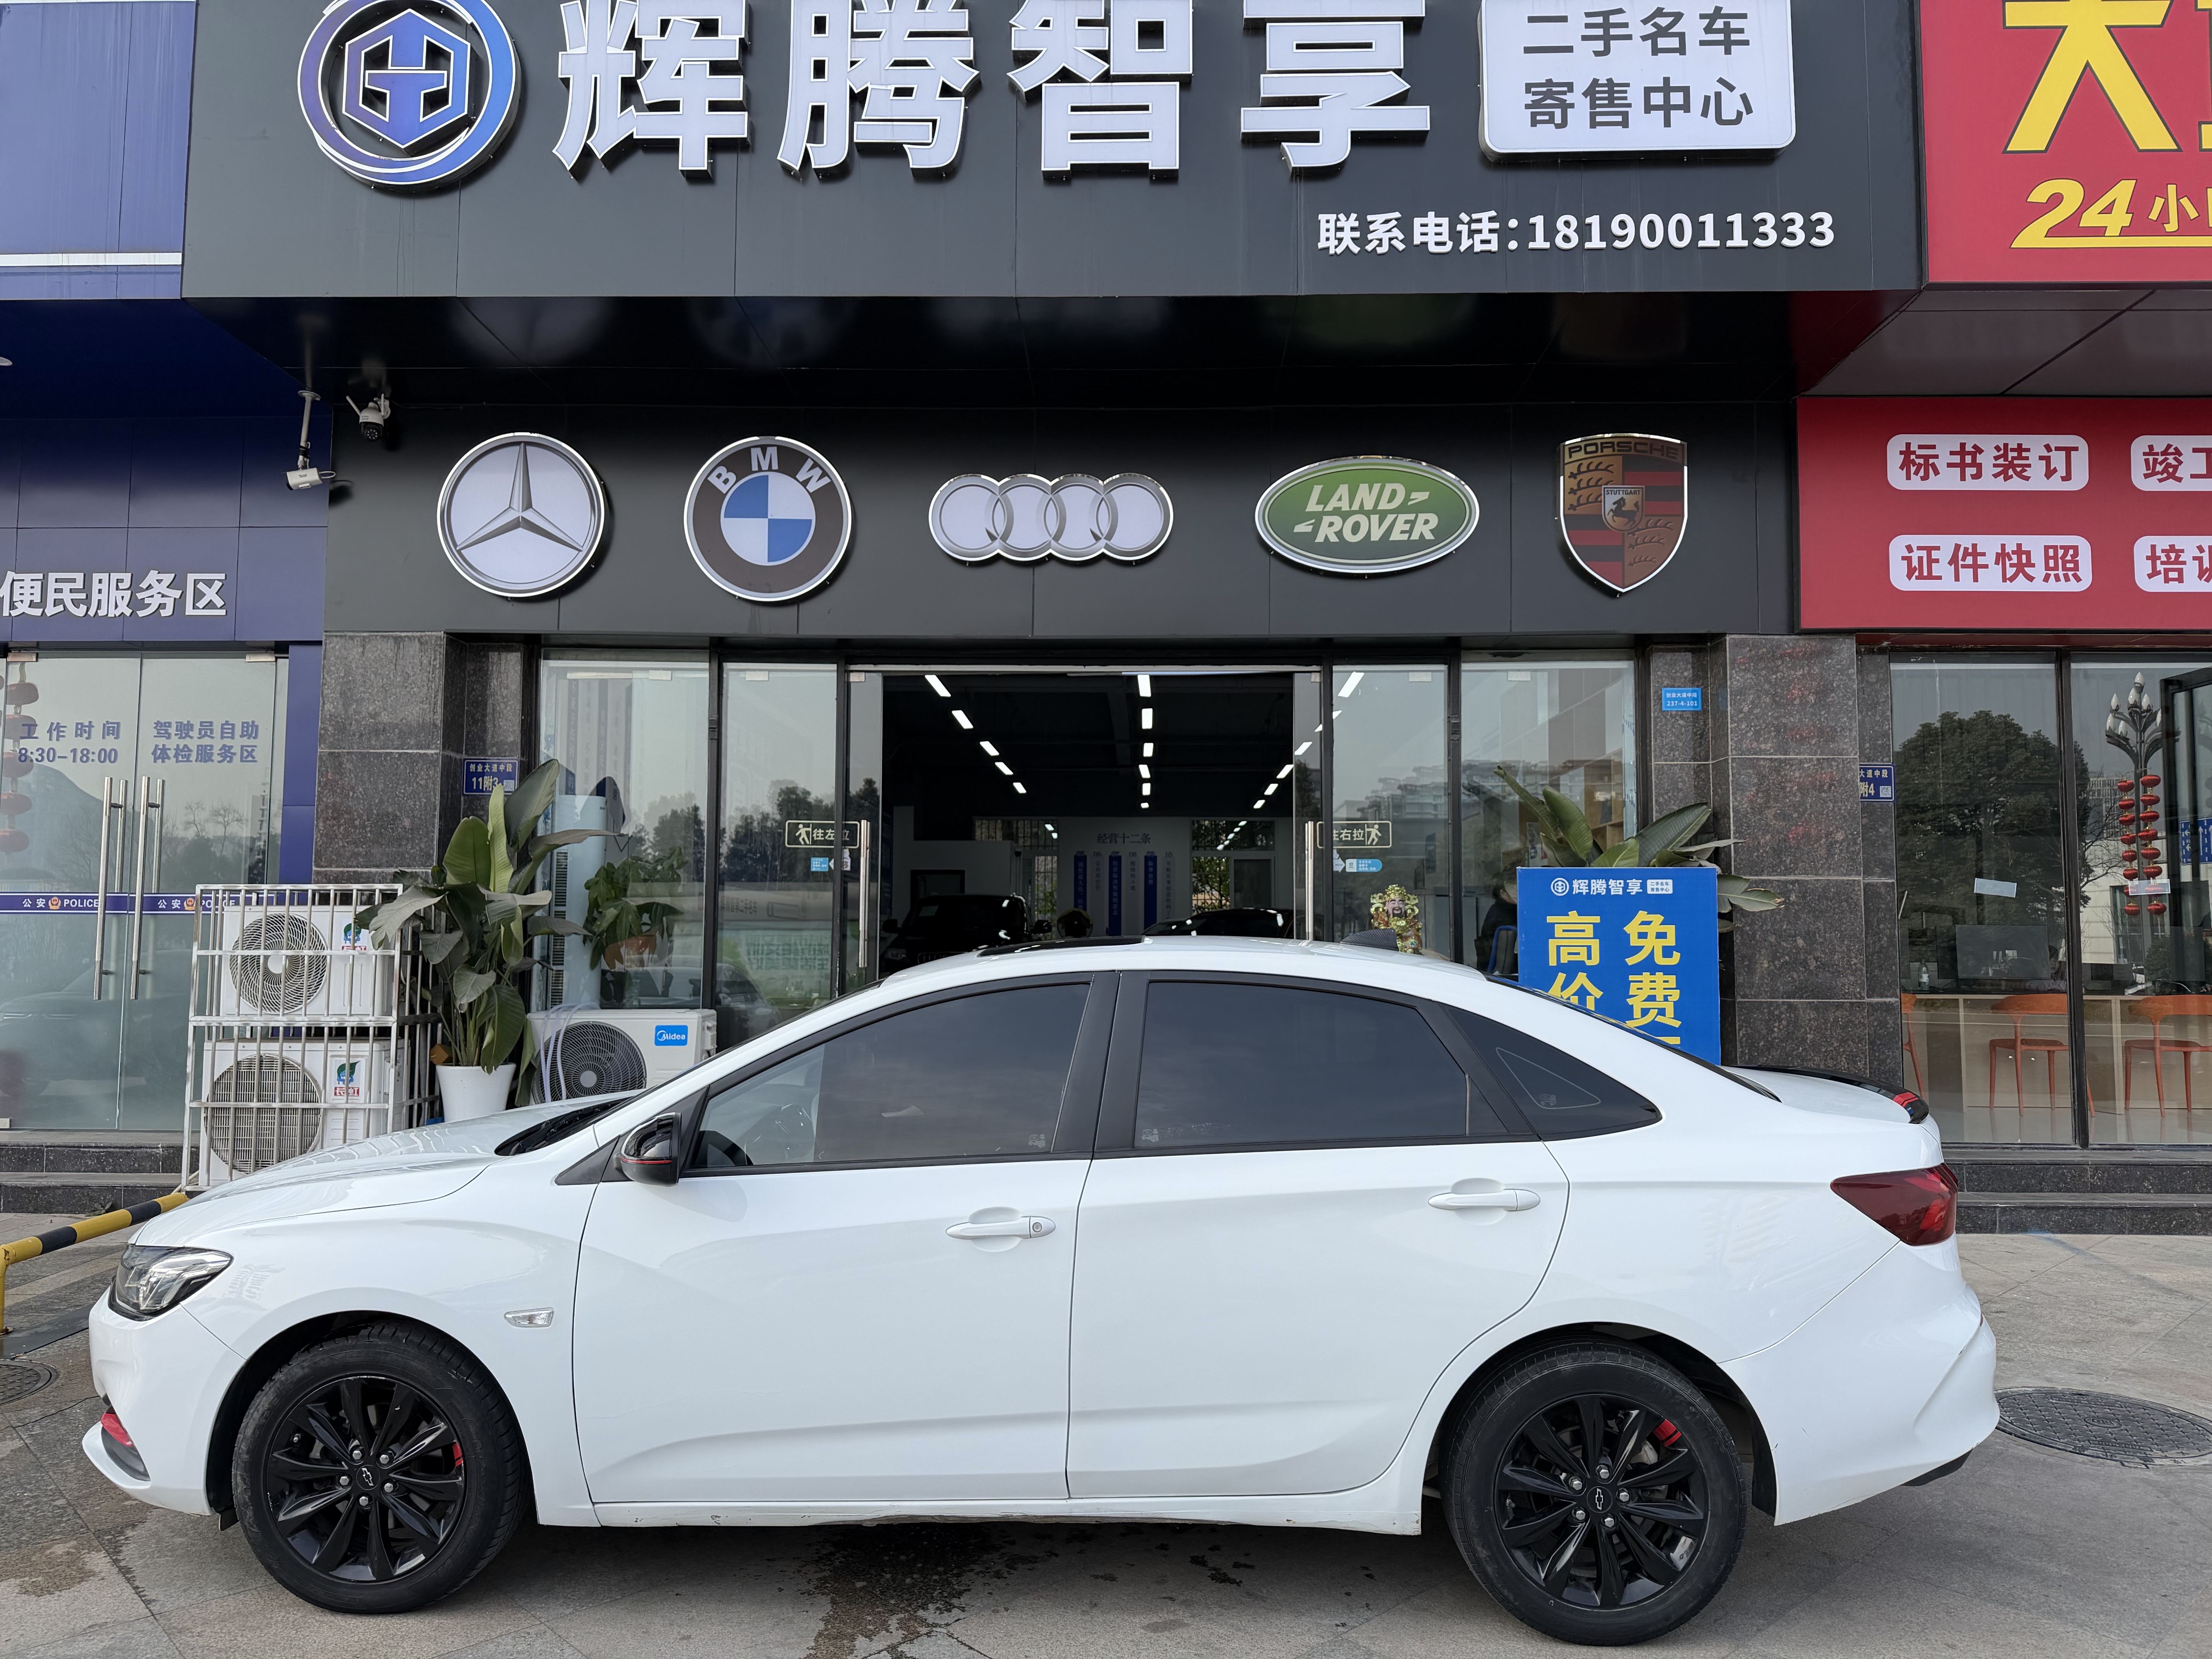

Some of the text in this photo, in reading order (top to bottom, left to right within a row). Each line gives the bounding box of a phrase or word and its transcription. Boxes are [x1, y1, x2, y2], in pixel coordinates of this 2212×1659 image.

[1523, 6, 1750, 57] 二手名车
[2002, 0, 2212, 154] 大
[553, 0, 1431, 177] 辉腾智享
[1524, 77, 1753, 130] 寄售中心
[2009, 178, 2212, 249] 24小
[1317, 210, 1835, 255] 联系电话:18190011333
[1568, 441, 1680, 460] PORSCHE
[707, 446, 831, 494] BMW
[1899, 442, 2080, 483] 标书装订
[1305, 483, 1406, 512] LAND
[1314, 513, 1438, 543] ROVER
[1901, 542, 2083, 584] 证件快照
[0, 570, 227, 618] 便民服务区
[20, 720, 121, 740] 工作时间
[153, 720, 259, 740] 驾驶员自助
[18, 747, 119, 764] 8:30-18:00
[151, 744, 258, 764] 体检服务区
[470, 763, 512, 773] 创业大道中段
[1859, 769, 1888, 778] 大道中段
[1859, 781, 1875, 797] 附4
[1097, 833, 1151, 844] 经营十二条
[1572, 878, 1643, 896] 辉腾智享
[22, 898, 99, 908] 公安 POLICE
[158, 898, 181, 908] 公安
[656, 1030, 686, 1041] Midea
[335, 1087, 359, 1096] 长虹
